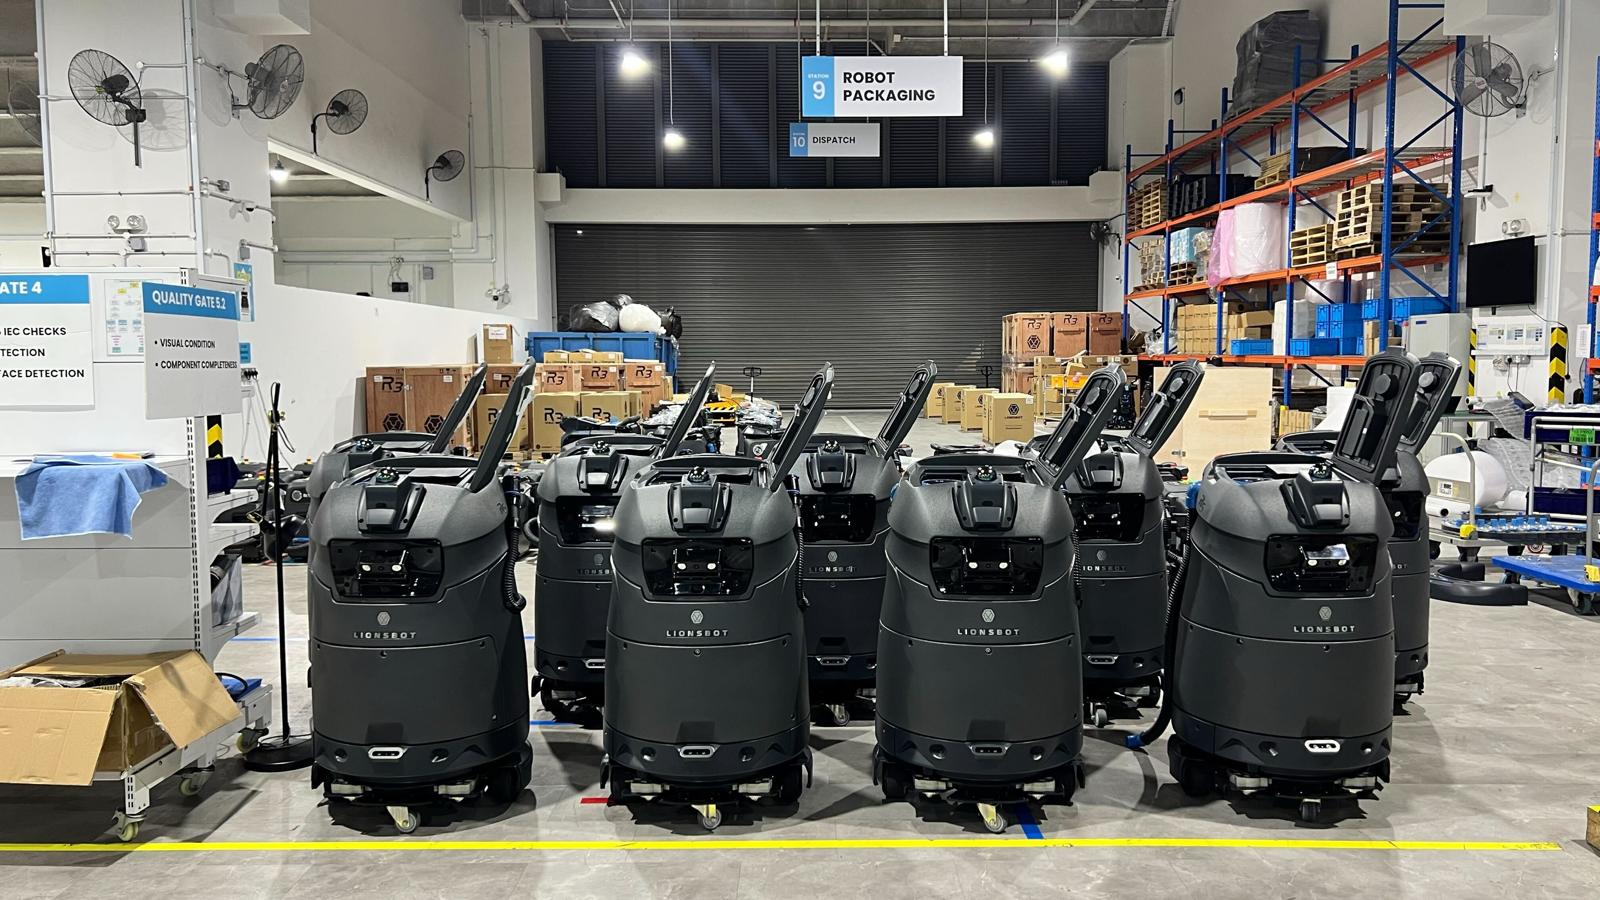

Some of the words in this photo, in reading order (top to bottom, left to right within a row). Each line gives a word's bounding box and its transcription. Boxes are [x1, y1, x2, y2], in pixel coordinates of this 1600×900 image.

[843, 71, 895, 84] ROBOT
[812, 80, 826, 100] 9
[843, 89, 935, 102] PACKAGING
[792, 136, 806, 148] 10
[812, 136, 856, 144] DISPATCH
[31, 281, 43, 294] 4
[152, 289, 194, 307] QUALITY
[194, 294, 216, 308] GATE
[216, 296, 227, 310] 5.2
[1028, 320, 1042, 330] R3
[1063, 314, 1078, 326] R3
[1099, 313, 1113, 325] R3
[3, 327, 20, 336] IEC
[22, 327, 67, 336] CHECKS
[160, 338, 184, 349] VISUAL
[184, 339, 216, 349] CONDITION
[160, 360, 200, 370] COMPONENT
[201, 360, 238, 370] COMPLETENESS
[0, 369, 23, 378] ACE
[25, 369, 85, 378] DETECTION
[591, 366, 608, 380] R3
[635, 365, 653, 379] R3
[381, 376, 404, 393] R3
[546, 371, 565, 386] R3
[544, 407, 564, 425] R3
[666, 629, 728, 638] LIONSBOT
[957, 628, 1020, 636] LIONSBOT
[1293, 625, 1355, 633] LIONSBOT
[353, 631, 417, 640] LIONSBOT
